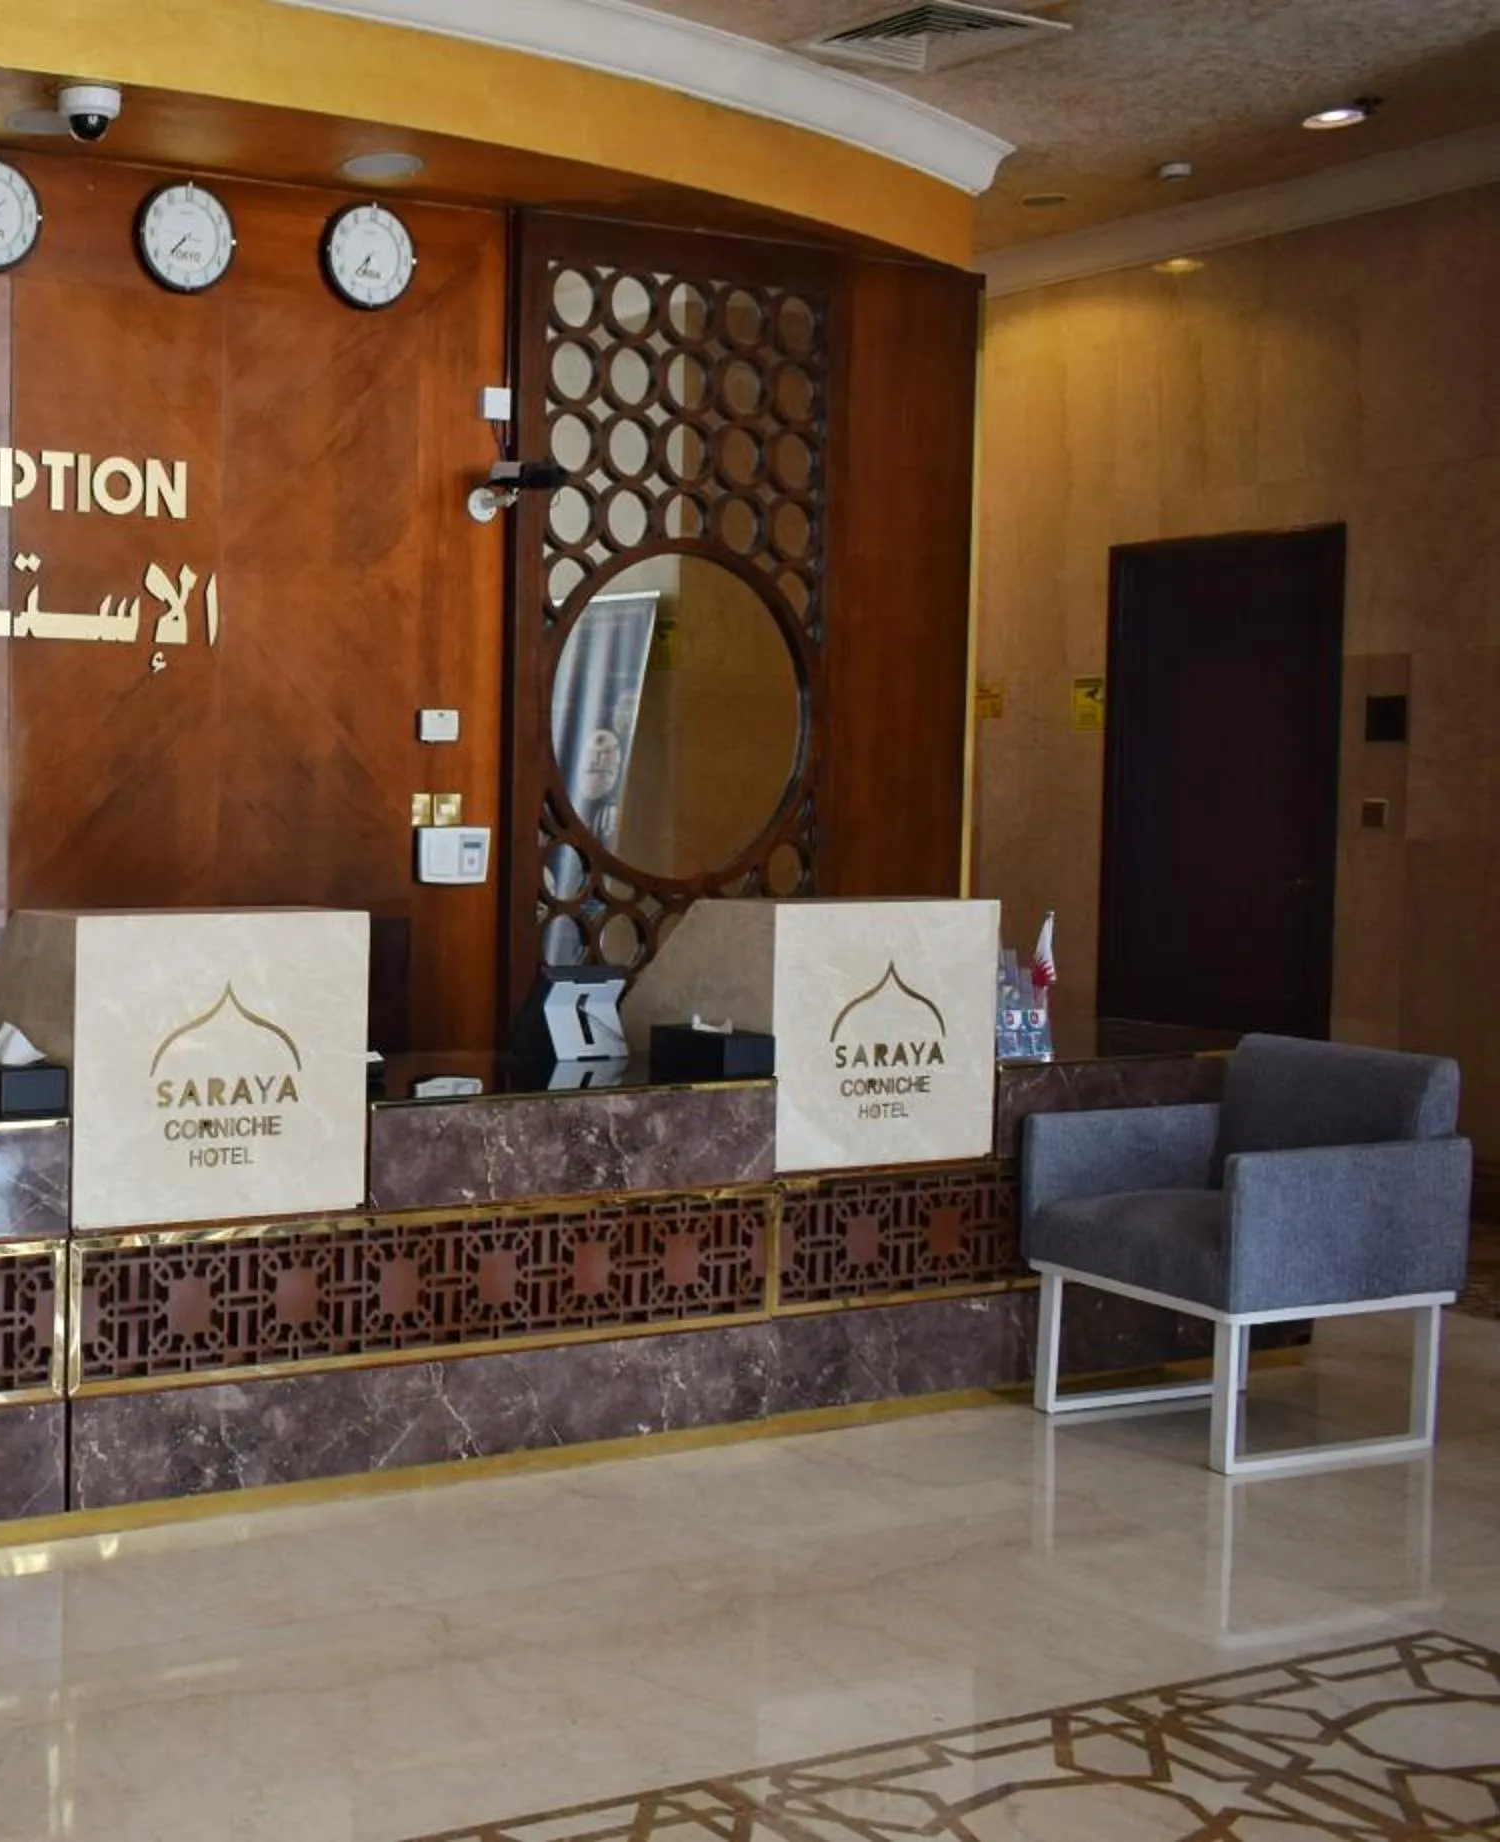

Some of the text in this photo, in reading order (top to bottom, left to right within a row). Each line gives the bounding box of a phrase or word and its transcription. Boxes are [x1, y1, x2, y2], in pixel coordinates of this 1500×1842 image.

[835, 1041, 945, 1069] SARAYA
[156, 1074, 299, 1109] SARAYA
[840, 1075, 931, 1097] CORNICHE
[858, 1101, 909, 1119] HOTEL
[164, 1114, 283, 1141] CORNICHE
[189, 1146, 254, 1168] HOTEL
